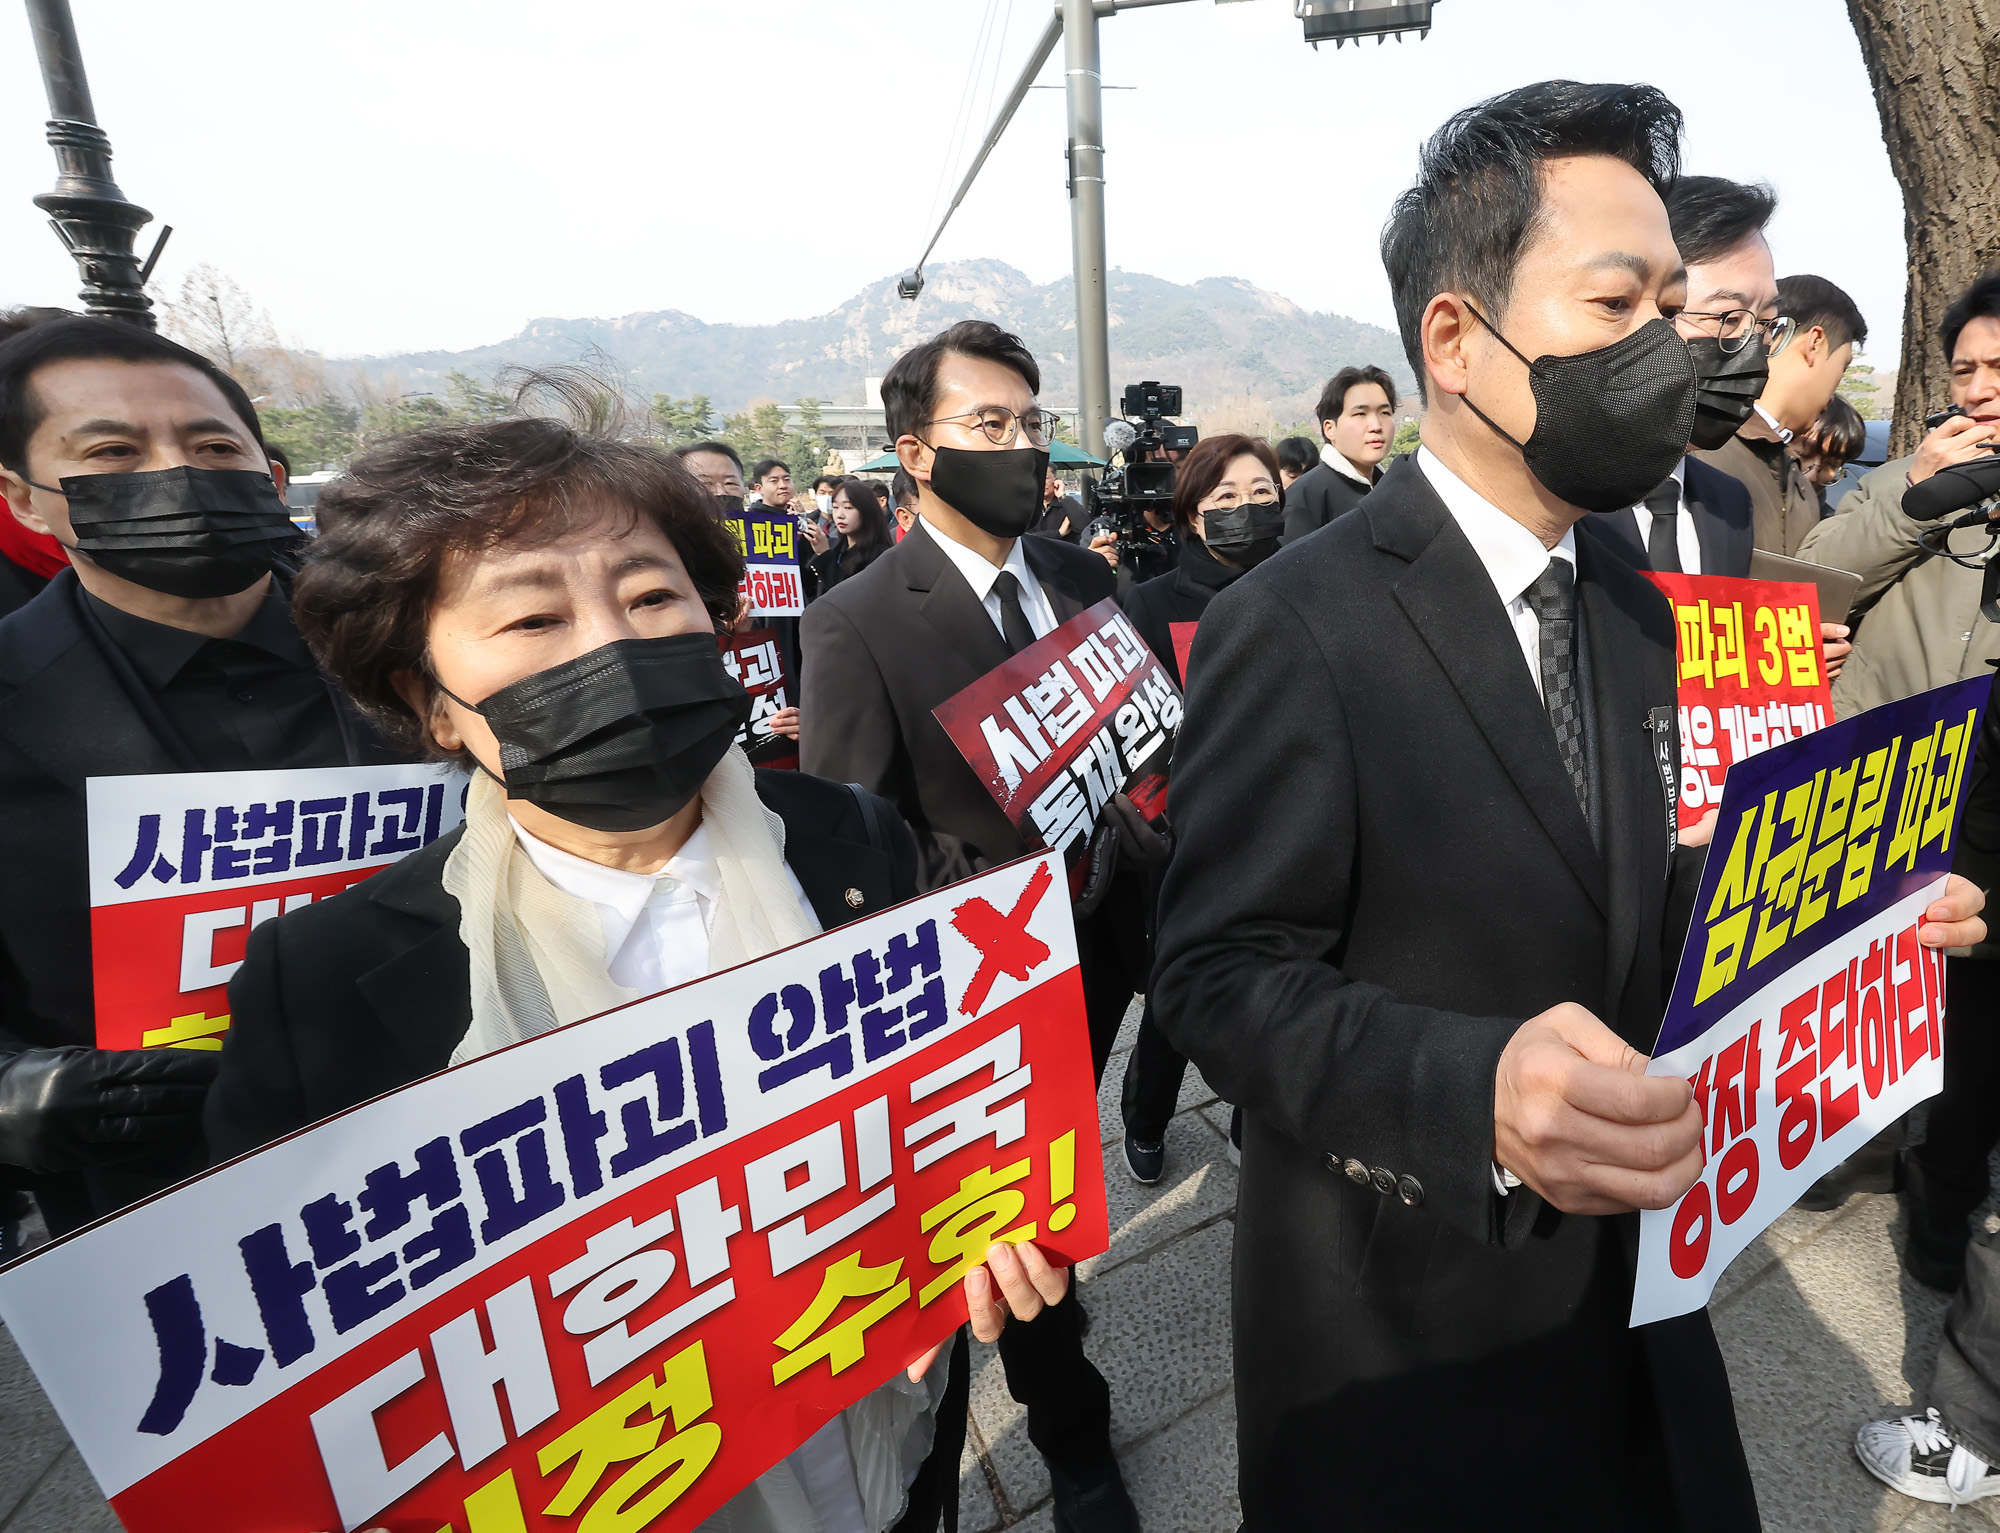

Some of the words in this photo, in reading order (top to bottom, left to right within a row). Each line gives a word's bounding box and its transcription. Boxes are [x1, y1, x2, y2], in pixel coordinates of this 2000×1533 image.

[751, 520, 794, 559] 파괴
[978, 659, 1096, 793] 사법
[1066, 612, 1150, 704] 파괴
[1669, 598, 1749, 689] 파괴
[1754, 604, 1820, 687] 3법
[114, 783, 445, 889] 사법파괴
[1027, 725, 1127, 853] 독재
[1114, 664, 1185, 773] 완성
[1693, 735, 1902, 1007] 삼권분립
[1884, 708, 1978, 872] 파괴
[137, 1019, 728, 1436] 사법파괴
[747, 919, 948, 1094] 악법
[309, 1024, 1032, 1533] 대한민국
[435, 1339, 722, 1533] 정
[772, 1129, 1077, 1387] 수호!
